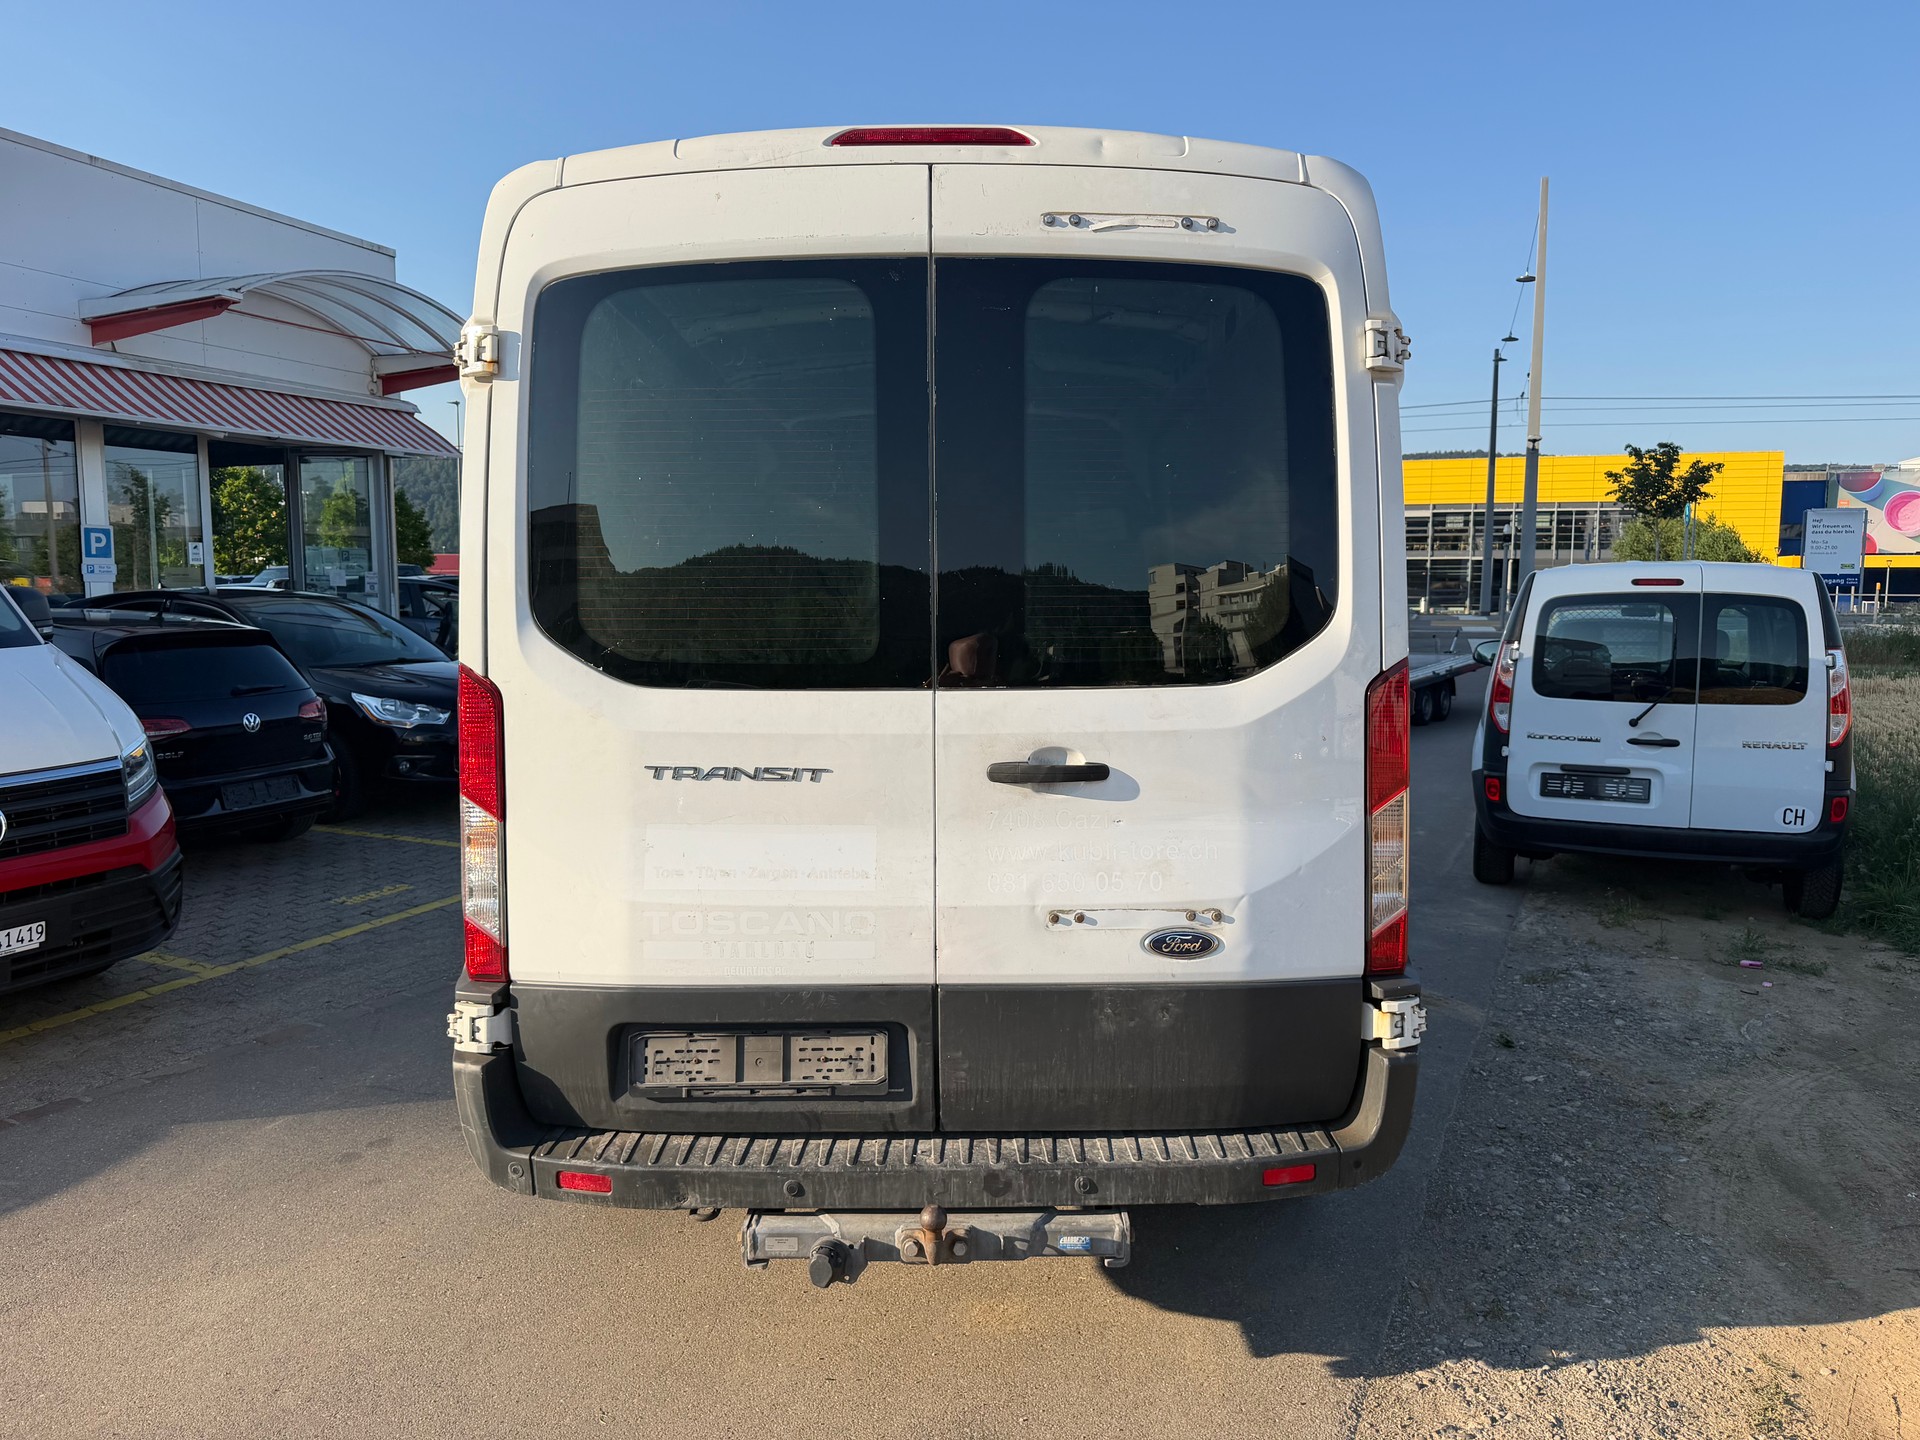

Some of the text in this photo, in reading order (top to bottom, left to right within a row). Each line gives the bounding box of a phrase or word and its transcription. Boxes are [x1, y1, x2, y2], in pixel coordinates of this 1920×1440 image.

[90, 532, 107, 555] P
[1742, 740, 1808, 750] RENAULT
[156, 751, 185, 760] GOLF
[644, 765, 834, 783] TRANSIT
[1782, 807, 1806, 827] CH
[1096, 871, 1124, 892] 05
[1135, 871, 1163, 892] 70
[642, 910, 876, 935] TOSCANO
[0, 924, 44, 950] 1419
[1162, 934, 1204, 952] Ford
